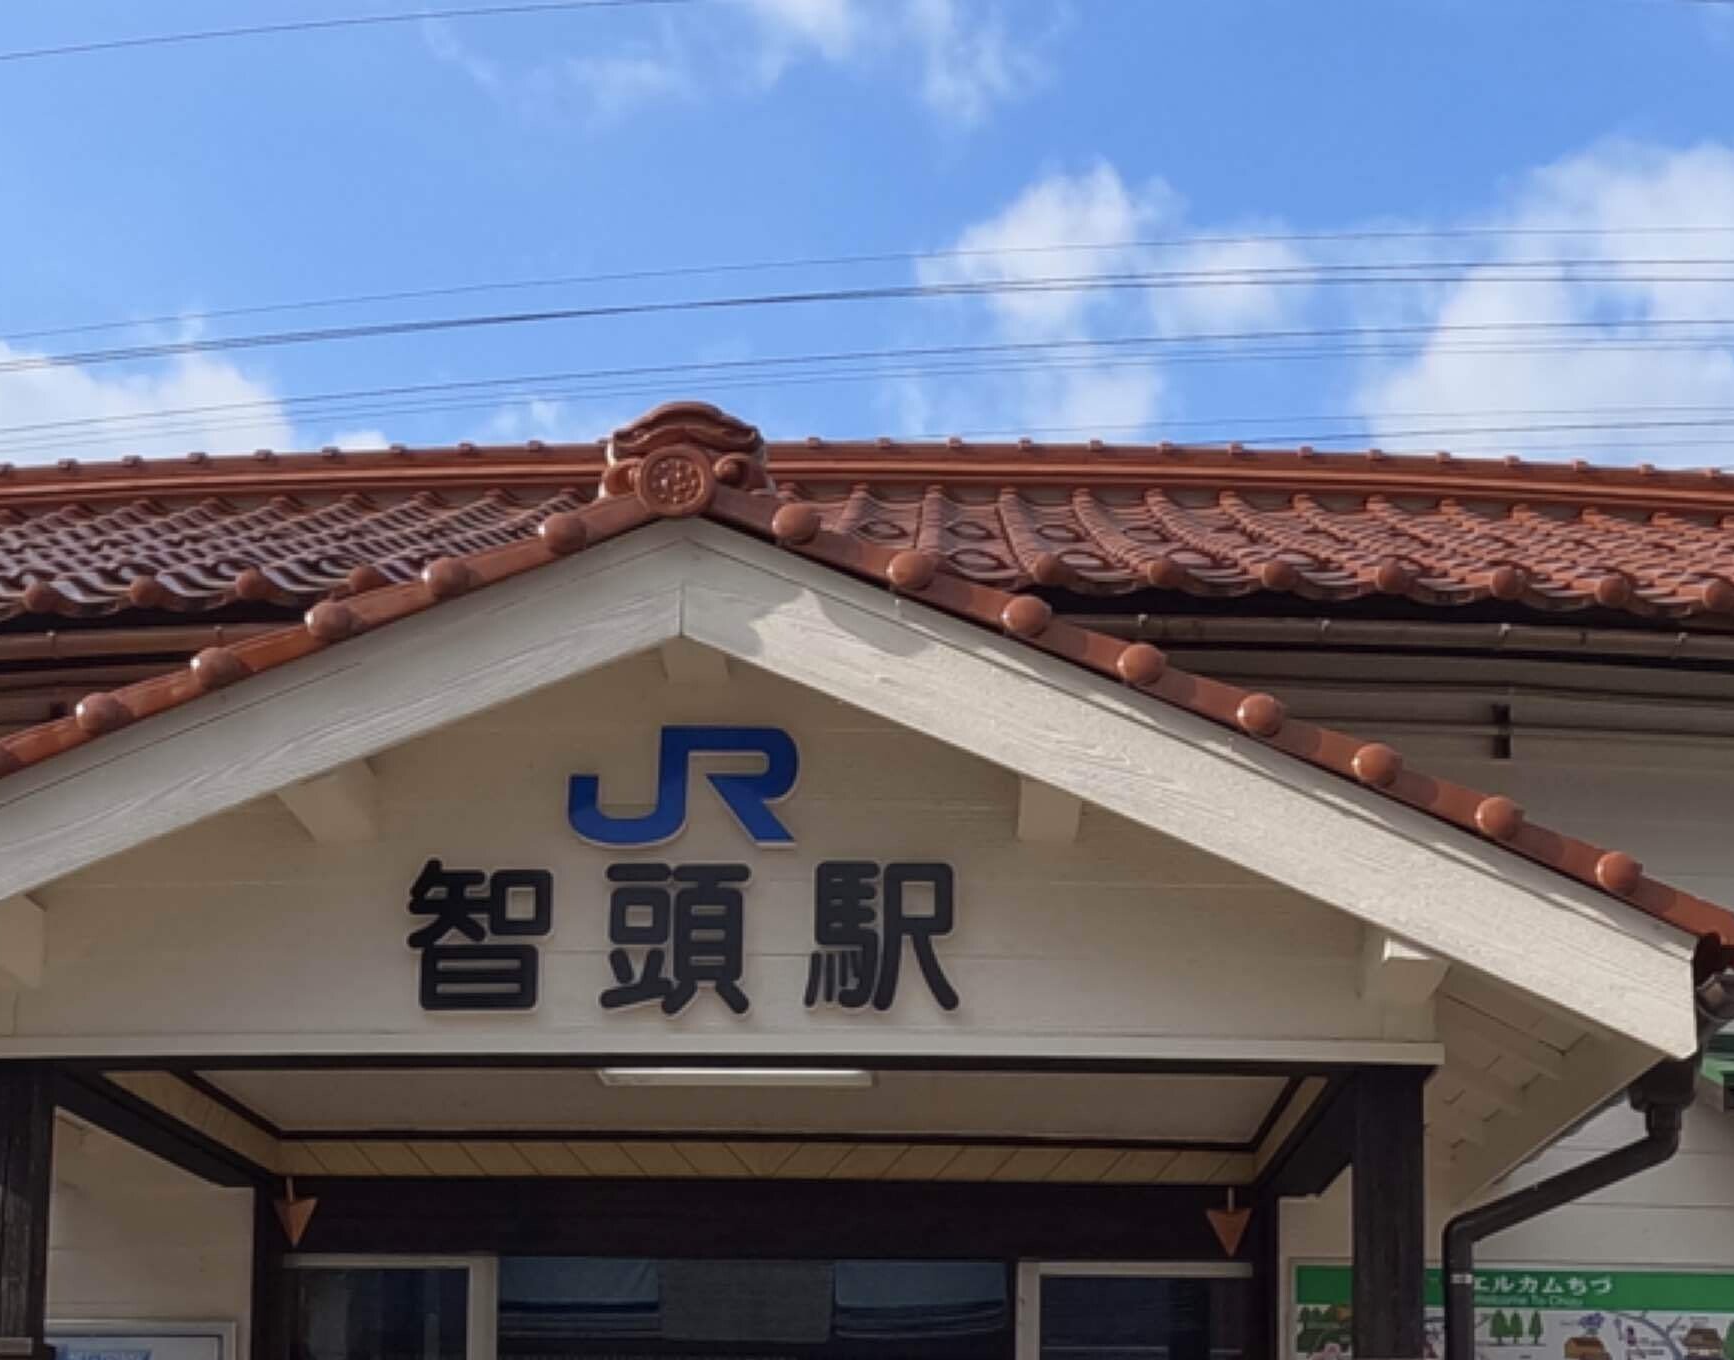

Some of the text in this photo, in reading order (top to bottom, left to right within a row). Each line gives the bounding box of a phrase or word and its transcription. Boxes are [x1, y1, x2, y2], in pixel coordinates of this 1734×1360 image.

[567, 725, 799, 846] JR
[407, 858, 959, 1015] 智頭駅
